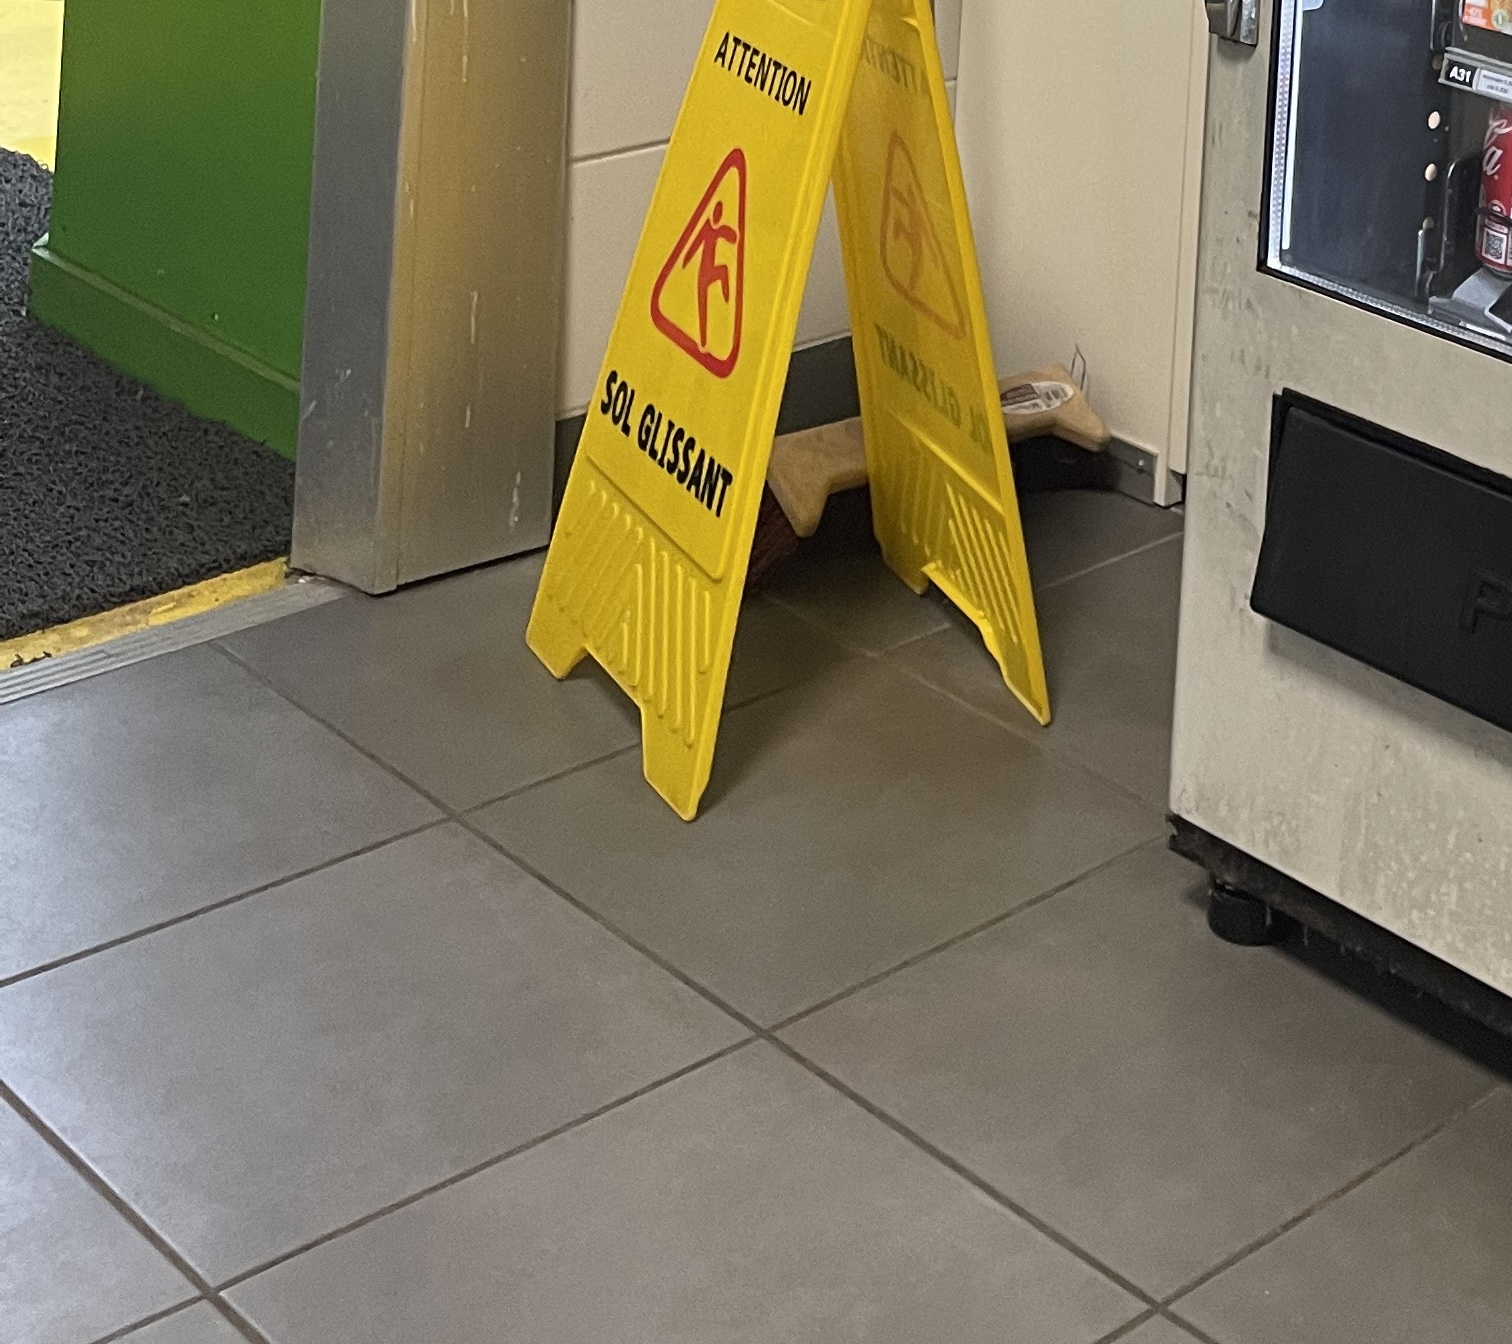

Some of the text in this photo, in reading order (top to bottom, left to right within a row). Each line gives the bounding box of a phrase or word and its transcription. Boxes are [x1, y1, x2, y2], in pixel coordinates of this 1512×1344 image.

[714, 31, 811, 117] ATTENTION
[1450, 65, 1472, 84] A31
[600, 370, 733, 519] SOL GLISSANT
